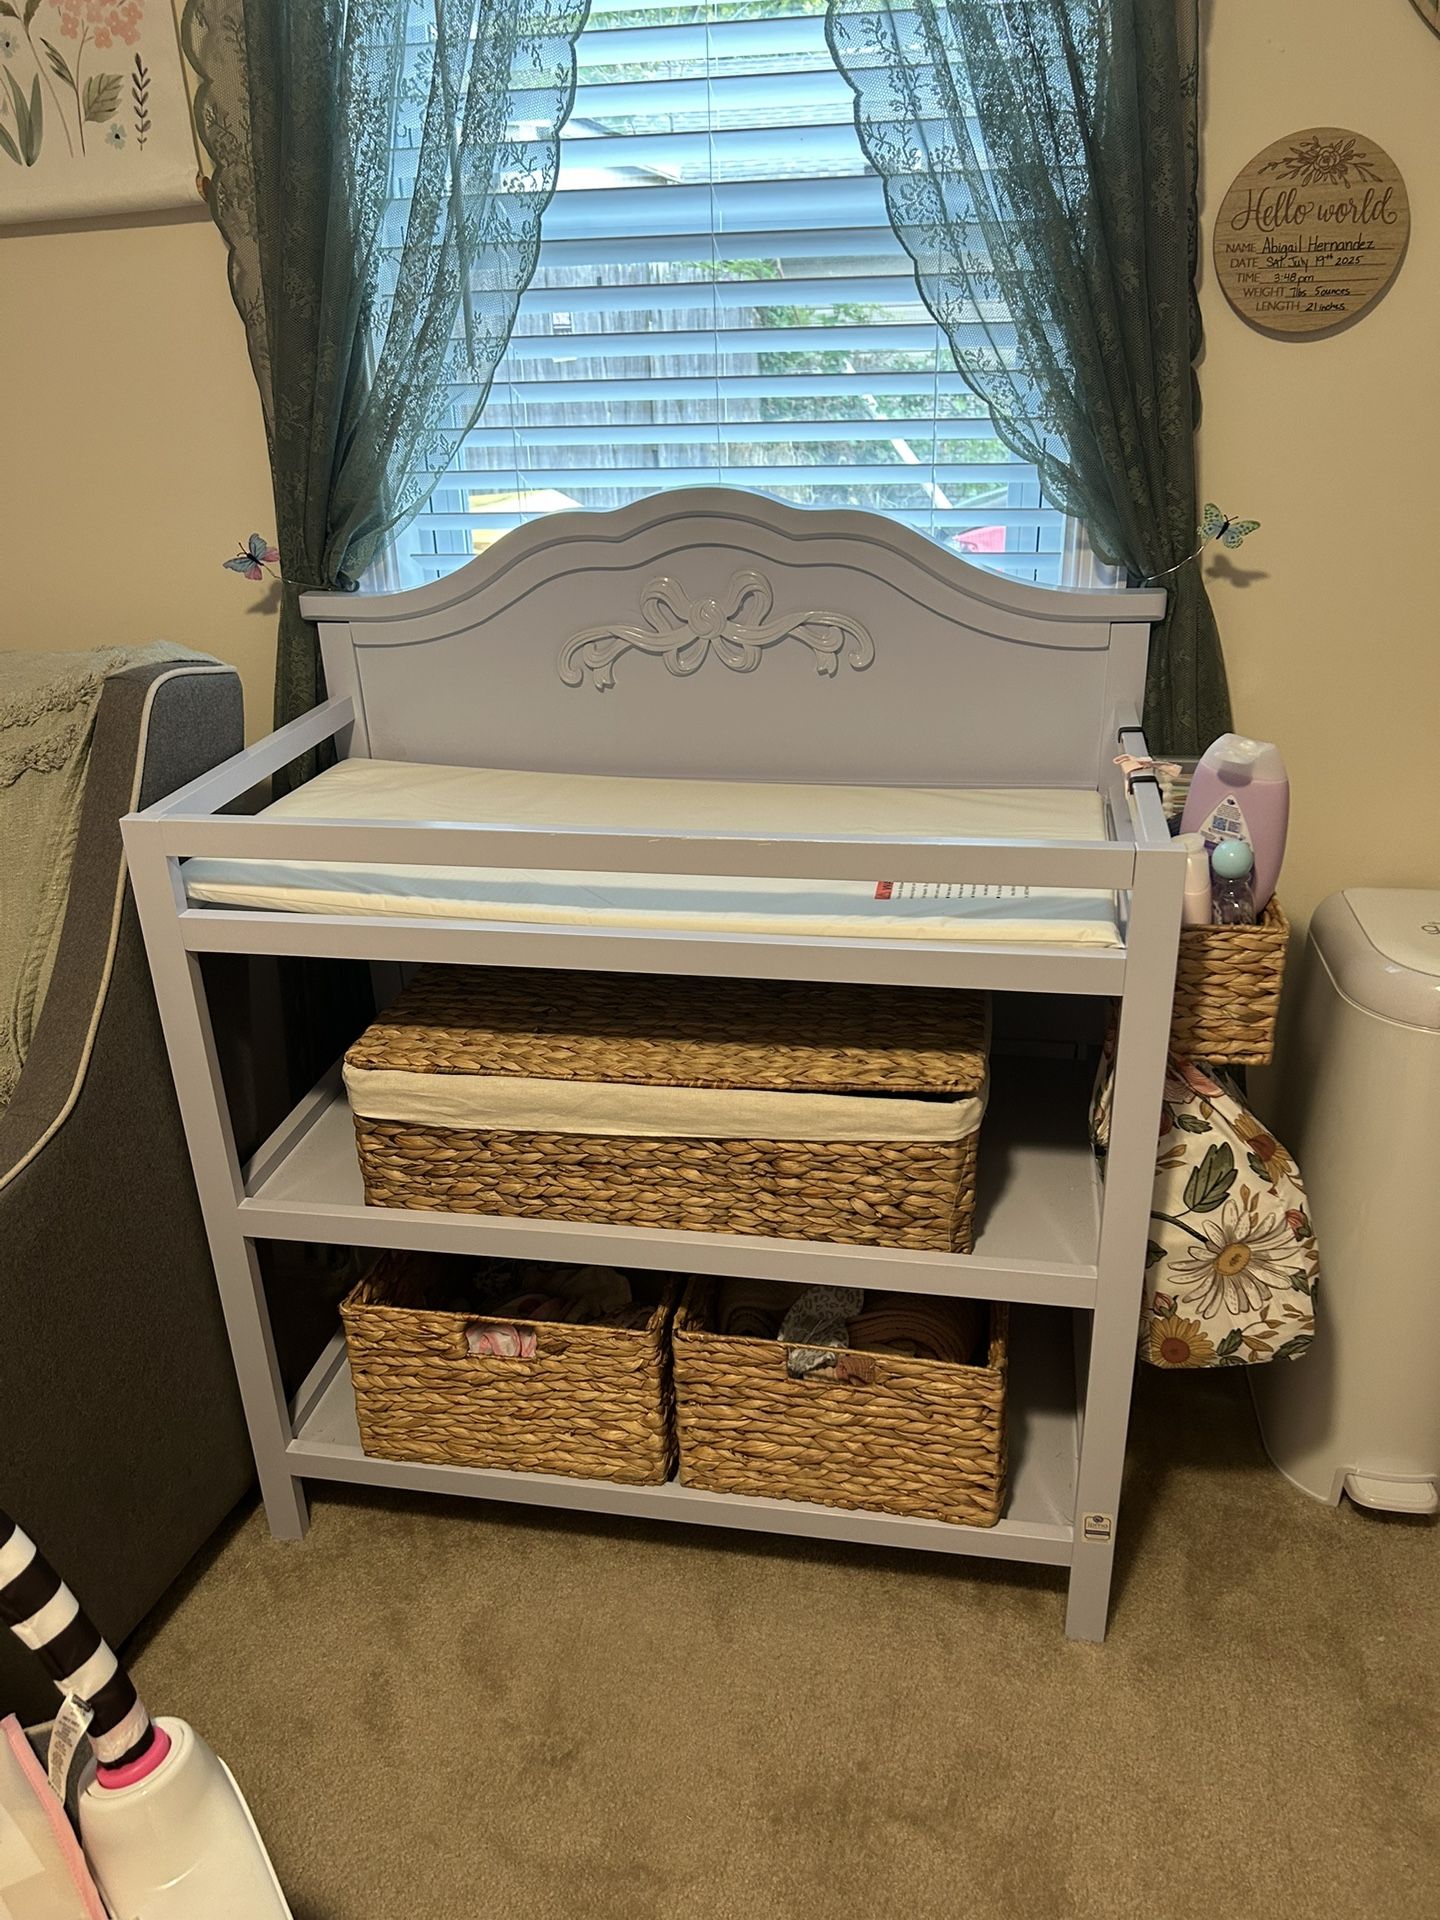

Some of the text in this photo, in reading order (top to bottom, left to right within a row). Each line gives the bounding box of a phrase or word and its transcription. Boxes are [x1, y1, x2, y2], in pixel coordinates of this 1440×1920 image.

[1231, 187, 1398, 232] Hello world
[1225, 232, 1375, 260] NAME Abigail Hernandez
[1230, 257, 1259, 268] DATE
[1288, 256, 1309, 272] July
[1335, 255, 1364, 266] 2025
[1237, 272, 1261, 283] TIME
[1243, 286, 1285, 298] WEIGHT
[1256, 300, 1300, 311] LENGTH
